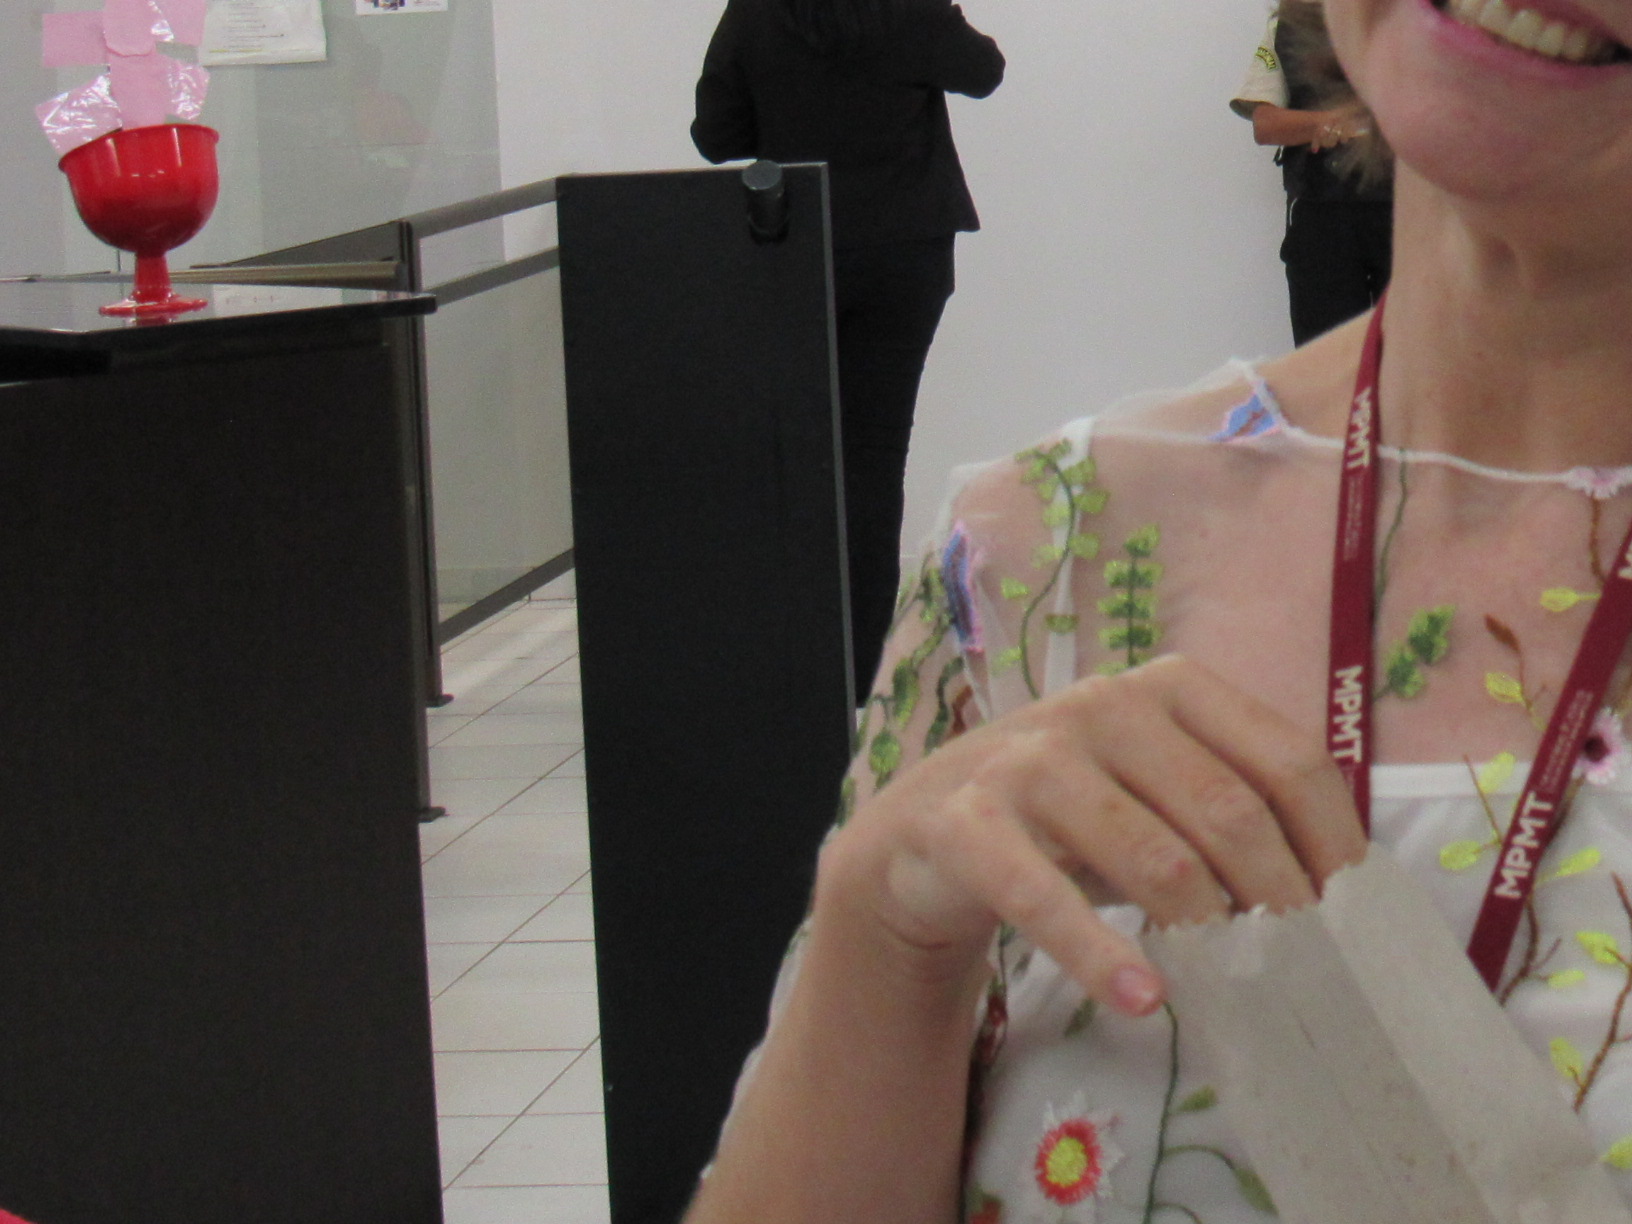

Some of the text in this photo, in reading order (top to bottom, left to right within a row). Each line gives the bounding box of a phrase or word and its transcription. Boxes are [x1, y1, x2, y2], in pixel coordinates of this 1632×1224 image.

[1346, 386, 1373, 469] MPMT
[1332, 664, 1364, 763] MPMT
[1494, 790, 1553, 898] MPMT
